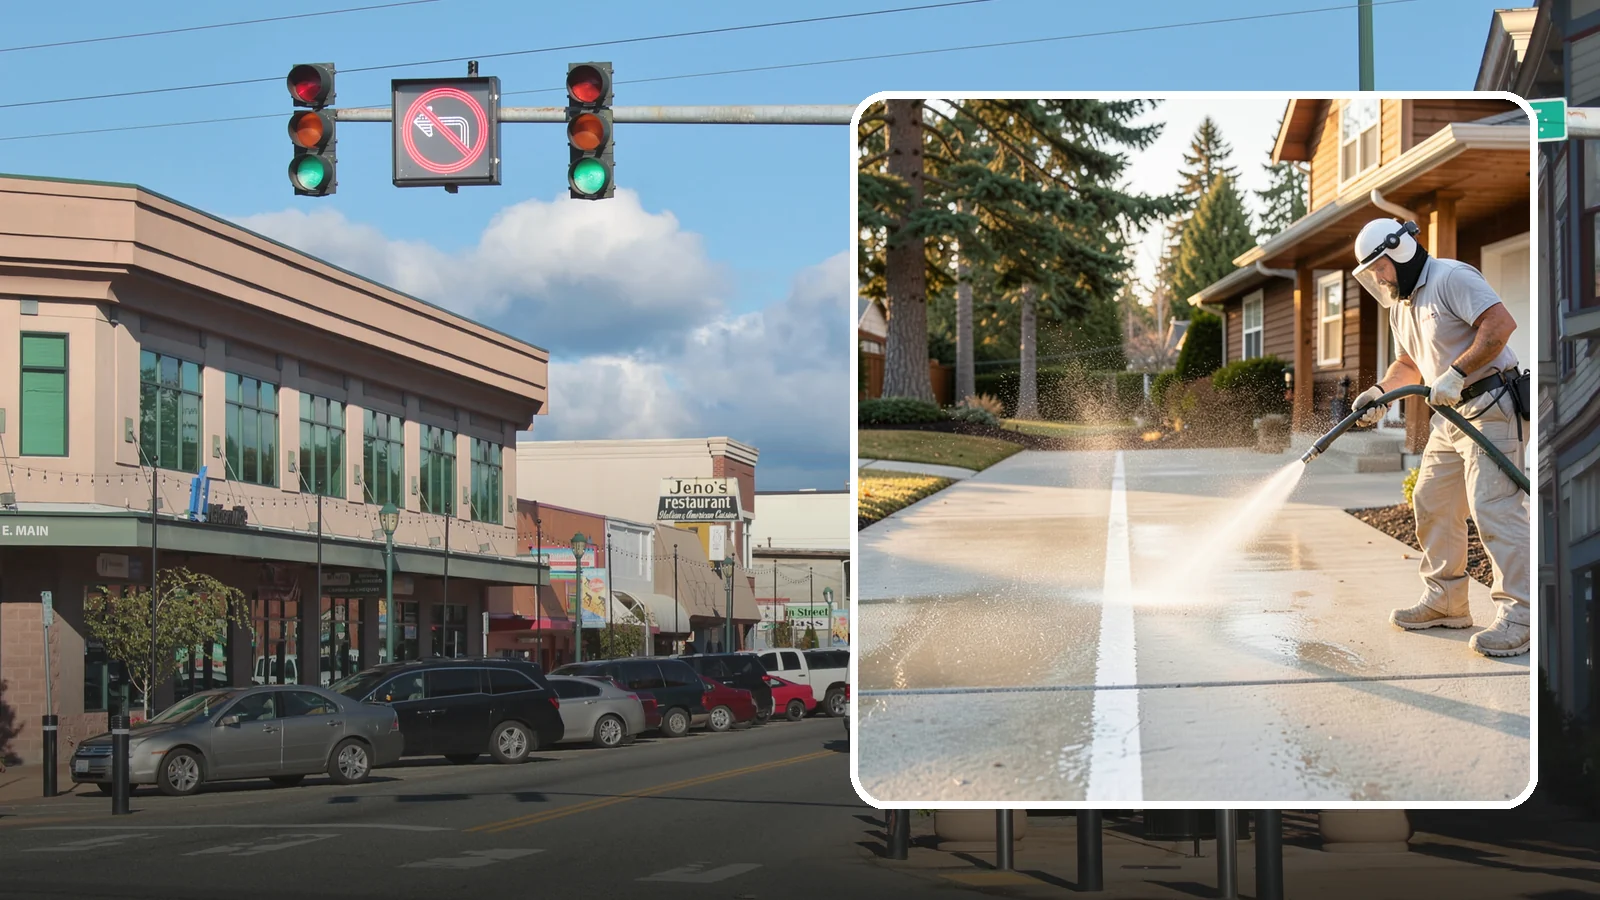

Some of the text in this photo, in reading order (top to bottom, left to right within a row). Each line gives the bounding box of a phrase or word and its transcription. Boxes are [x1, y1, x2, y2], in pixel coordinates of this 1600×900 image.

[670, 480, 728, 494] Jeno's
[665, 496, 731, 509] restaurant
[686, 509, 714, 519] American
[715, 509, 738, 519] Cuisine
[2, 525, 49, 537] E. MAIN
[785, 607, 795, 617] in
[797, 607, 828, 617] Street
[790, 619, 824, 627] lass
